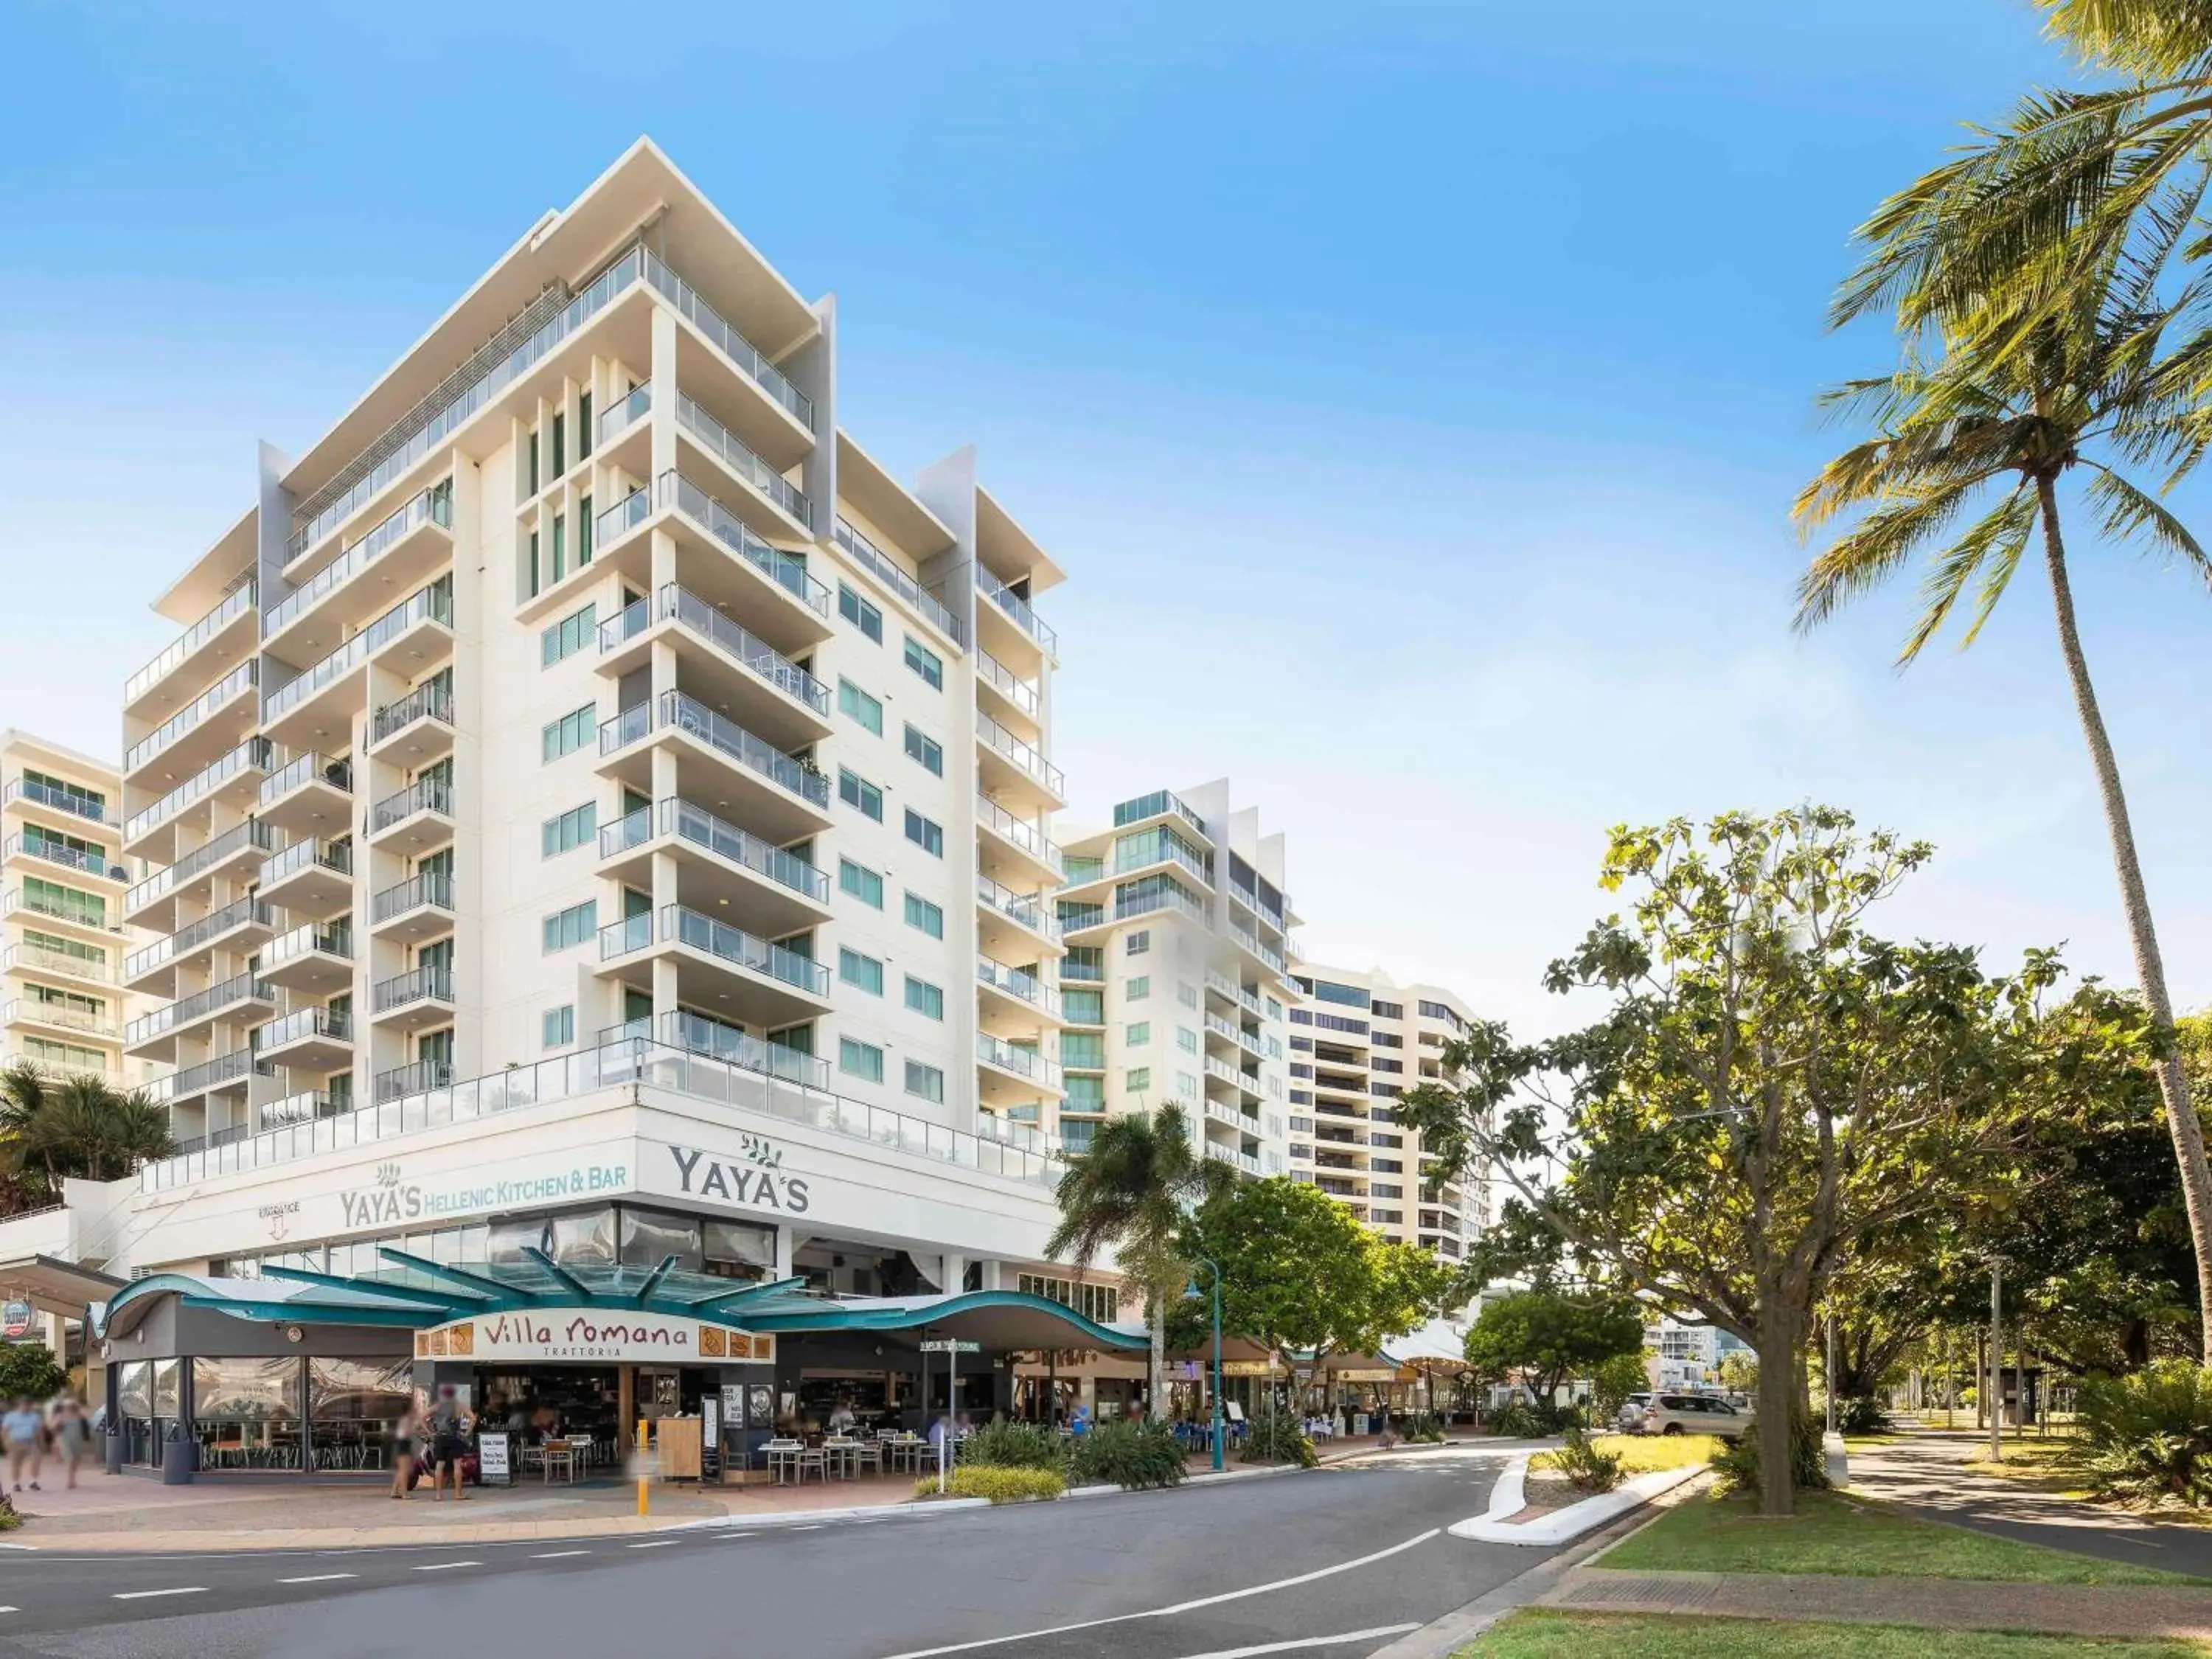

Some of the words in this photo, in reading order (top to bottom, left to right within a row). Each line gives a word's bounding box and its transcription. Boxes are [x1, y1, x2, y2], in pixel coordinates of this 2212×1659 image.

[424, 1186, 494, 1215] HELLENIC
[570, 1169, 583, 1193] &
[588, 1166, 626, 1190] BAR
[485, 1315, 552, 1345] Villa
[544, 1347, 621, 1357] TRATTORIA
